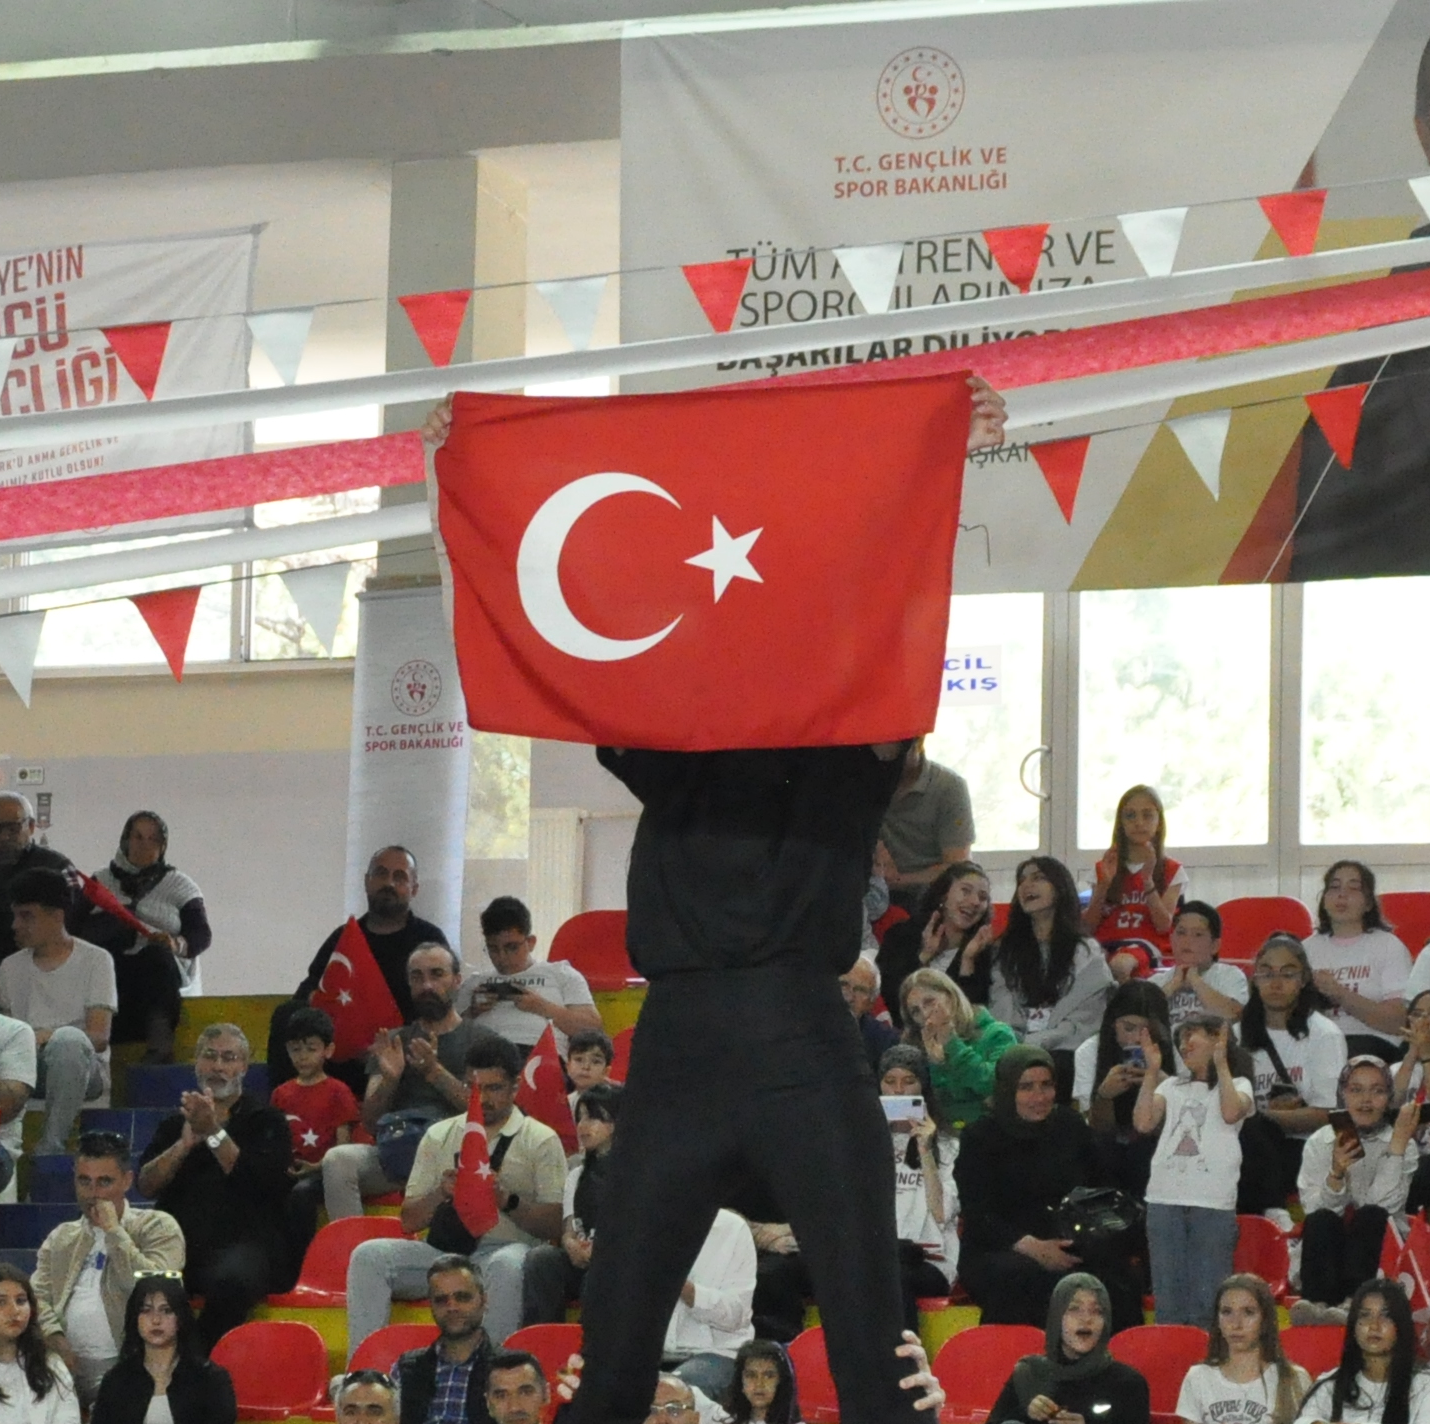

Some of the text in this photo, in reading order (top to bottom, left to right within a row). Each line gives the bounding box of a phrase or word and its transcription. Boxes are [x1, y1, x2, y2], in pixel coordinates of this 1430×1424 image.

[834, 146, 1007, 174] T.C. GENÇLİK VE
[834, 169, 1008, 199] SPOR BAKANLIĞI
[1066, 229, 1115, 266] VE
[943, 653, 993, 671] CİL
[947, 677, 998, 691] KIŞ
[365, 720, 464, 737] T.C. GENÇLİK VE
[365, 735, 463, 752] SPOR BAKANLIĞI
[1117, 912, 1144, 928] 27
